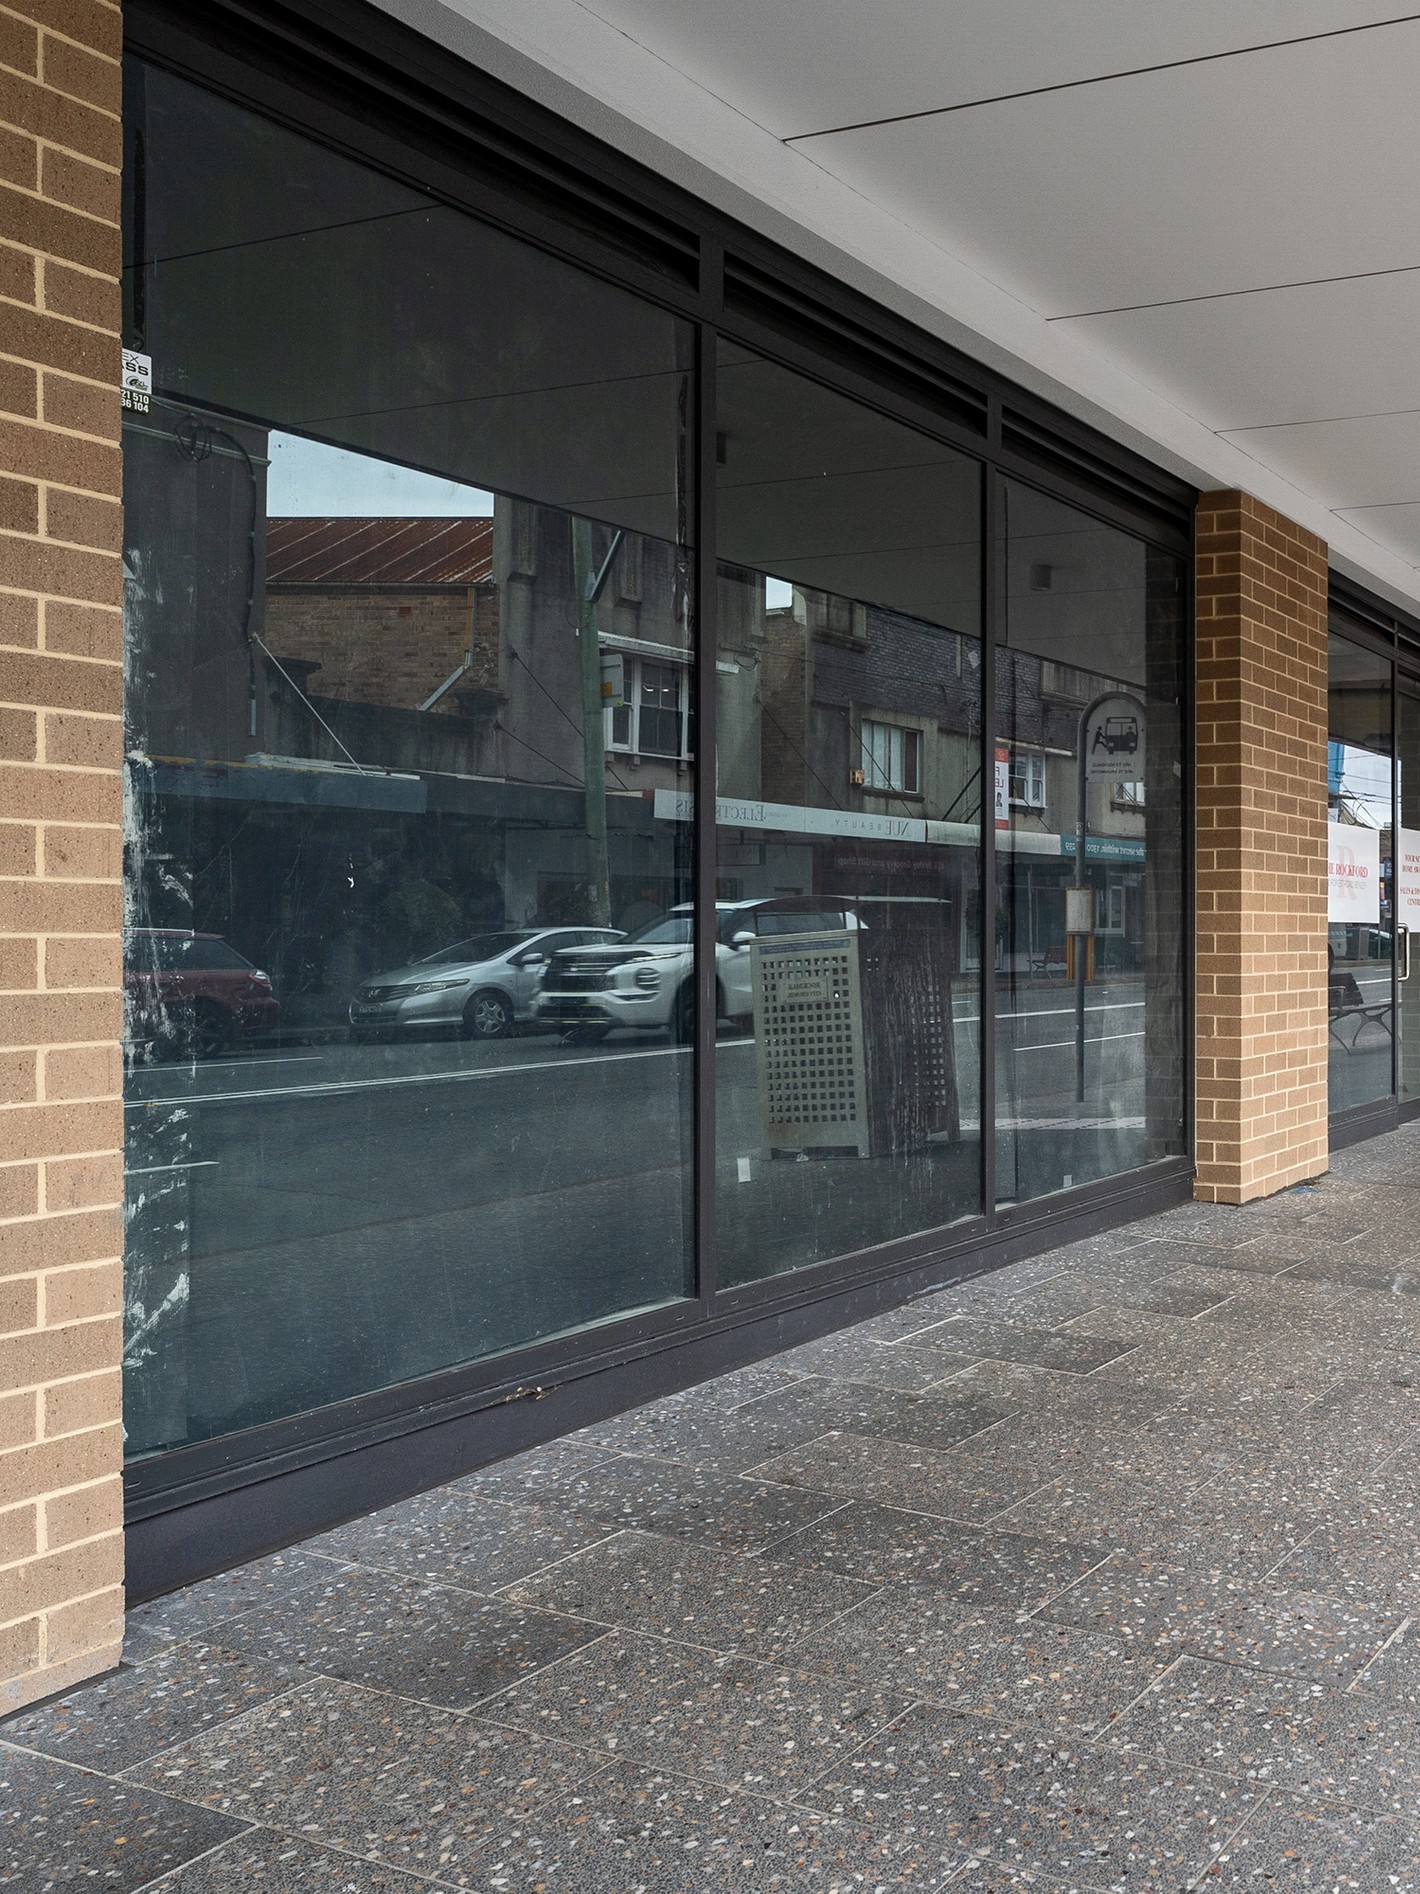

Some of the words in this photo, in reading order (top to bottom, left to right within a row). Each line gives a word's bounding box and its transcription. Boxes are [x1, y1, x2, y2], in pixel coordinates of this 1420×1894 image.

[121, 361, 149, 377] SS
[132, 391, 149, 404] 510
[132, 401, 149, 413] 104
[1336, 863, 1369, 878] ROCKFORD
